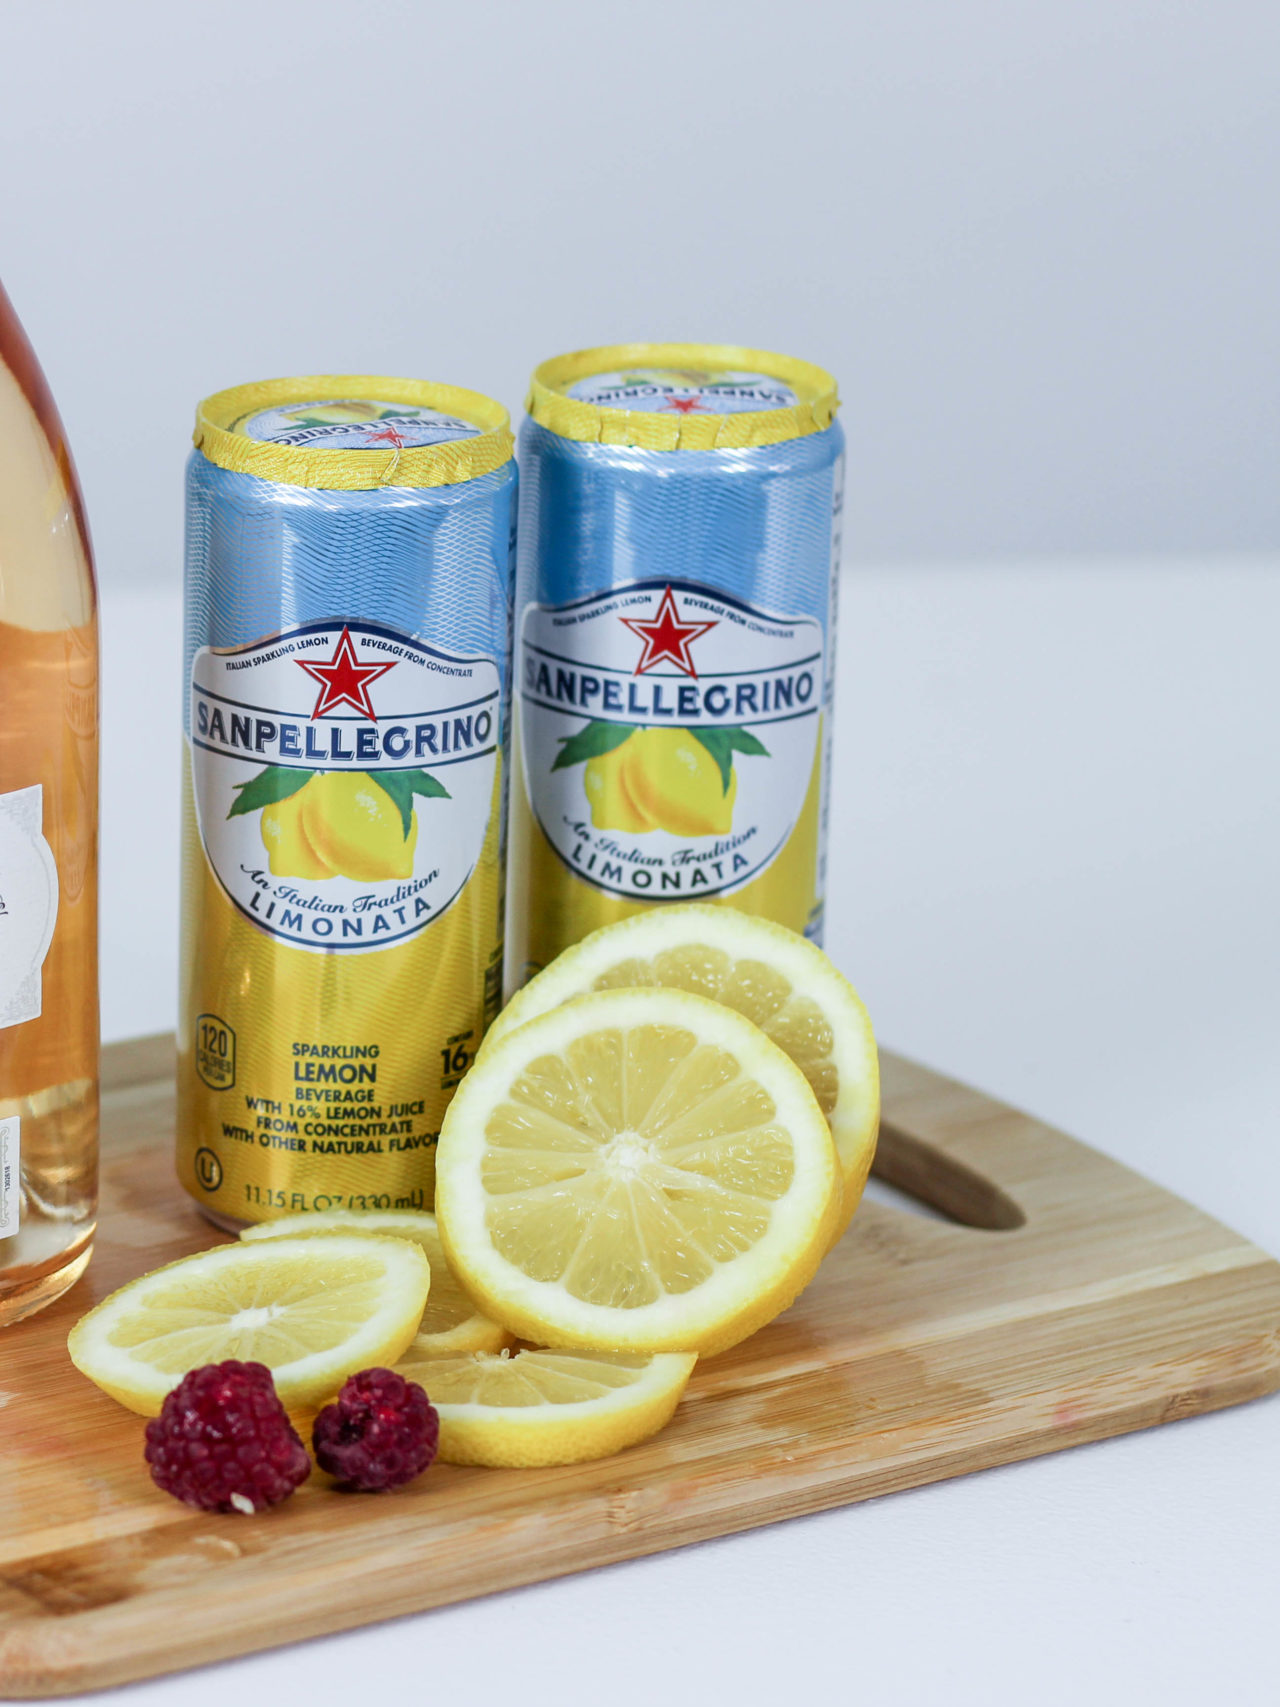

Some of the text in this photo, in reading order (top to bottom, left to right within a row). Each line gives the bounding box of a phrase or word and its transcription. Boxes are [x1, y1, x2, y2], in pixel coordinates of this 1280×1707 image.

[578, 602, 619, 622] SPARKLING
[621, 595, 652, 607] LEMON
[683, 597, 725, 616] BEVERAGE
[726, 611, 747, 626] FROM
[226, 636, 473, 678] ITALIAN SPARKLING LEMON BEVERAGE FROM CONCENTRATE
[525, 659, 814, 718] SANPELLEGRINO
[197, 709, 492, 761] SANPELLEGRINO
[563, 814, 758, 868] An Italian Tradition
[572, 843, 750, 890] LIMONATA
[240, 863, 441, 914] An Italian Tradition
[249, 890, 432, 937] LIMONATA
[201, 1023, 228, 1058] 120
[292, 1042, 380, 1059] SPARKLING
[294, 1062, 377, 1084] LEMON
[245, 1095, 425, 1120] WITH 16% LEMON JUICE
[295, 1087, 375, 1103] BEVERAGE
[222, 1123, 255, 1144] WITH
[259, 1133, 307, 1153] OTHER
[312, 1139, 384, 1155] NATURAL
[257, 1116, 413, 1137] FROM CONCENTRATE
[245, 1184, 287, 1208] 11.15
[291, 1193, 309, 1212] FL
[395, 1188, 424, 1210] mL)
